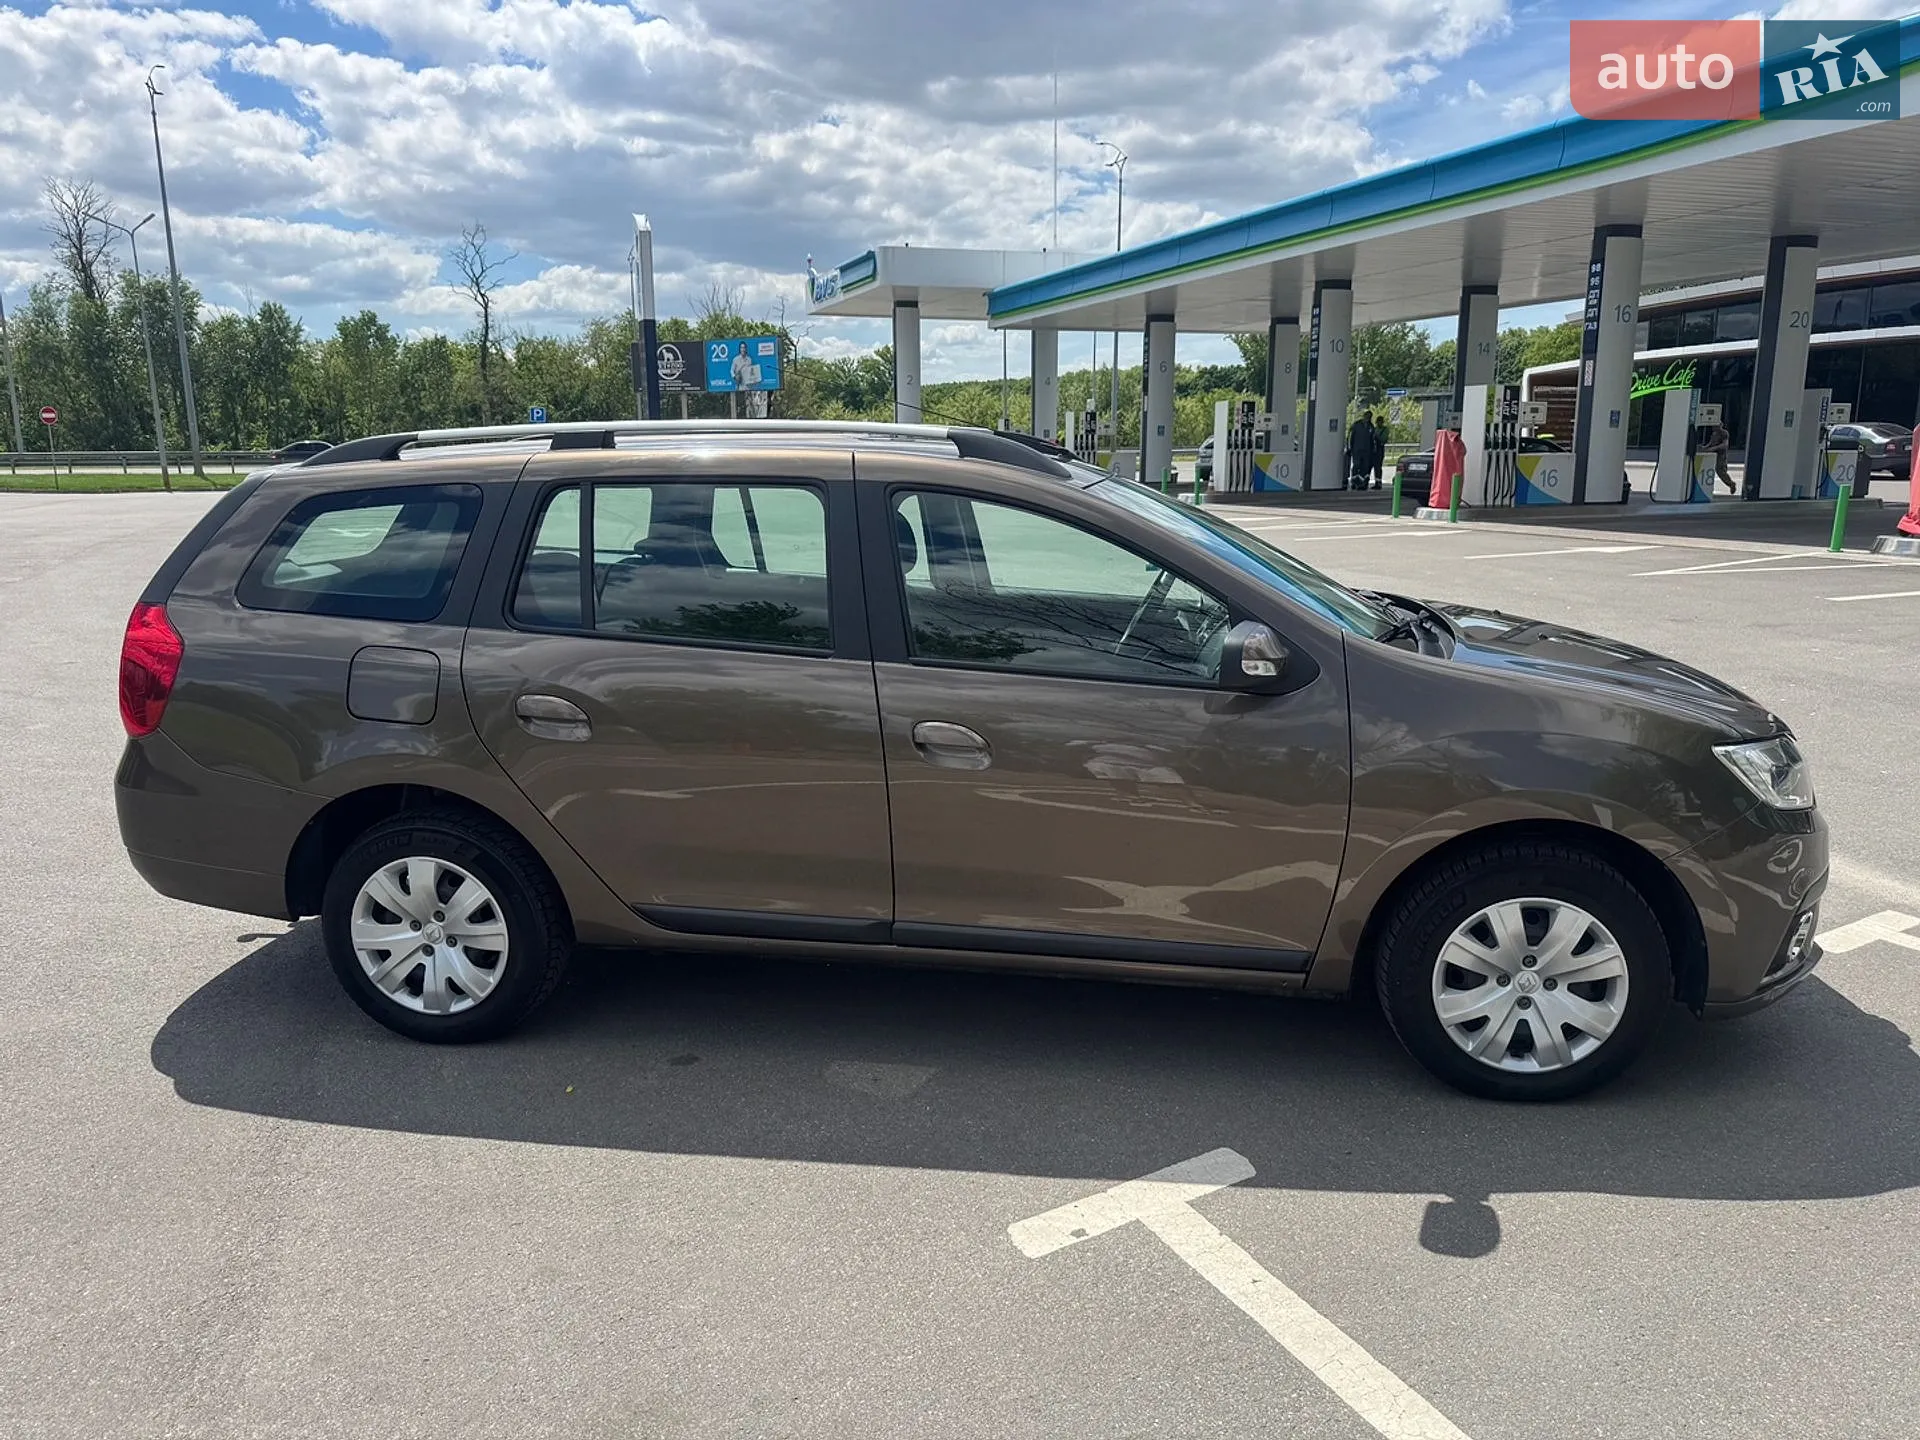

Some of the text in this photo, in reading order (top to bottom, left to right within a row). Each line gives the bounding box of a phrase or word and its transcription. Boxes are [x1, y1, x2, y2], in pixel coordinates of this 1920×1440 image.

[1614, 304, 1632, 323] 16
[1790, 311, 1809, 328] 20
[711, 344, 728, 359] 20
[1329, 339, 1344, 353] 10
[1478, 341, 1490, 354] 14
[1159, 360, 1168, 373] 6
[1285, 362, 1292, 374] 8
[906, 374, 914, 385] 2
[1044, 376, 1052, 386] 4
[1663, 359, 1698, 390] Café
[533, 408, 543, 420] P
[1274, 464, 1290, 479] 10
[1540, 469, 1559, 488] 16
[1701, 468, 1716, 486] 18
[1836, 464, 1855, 481] 20
